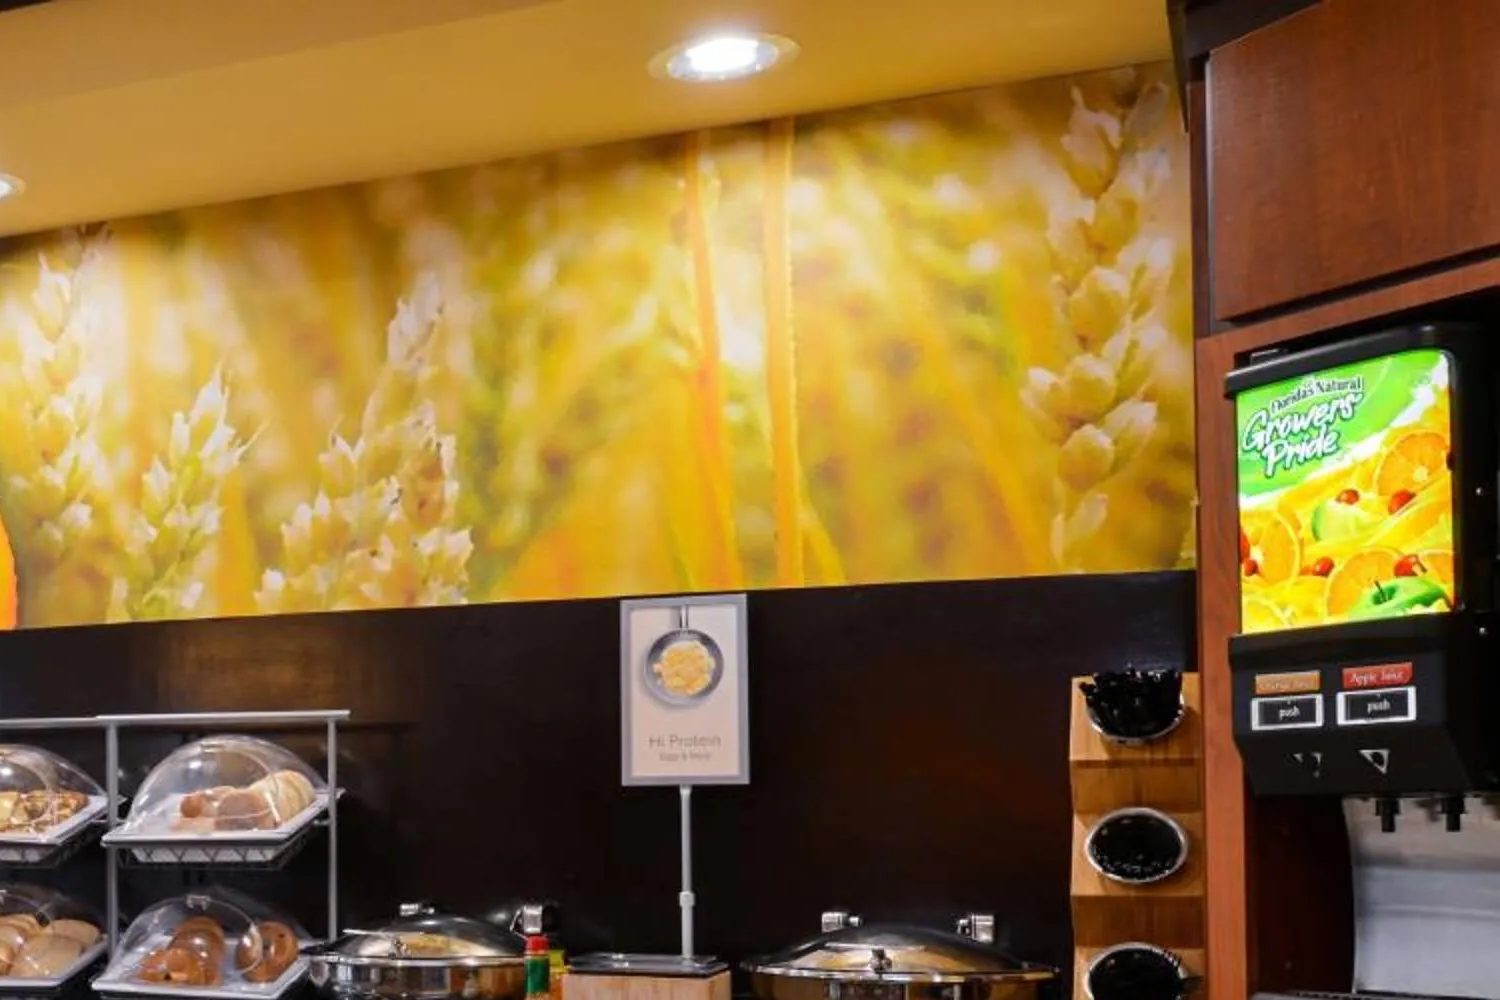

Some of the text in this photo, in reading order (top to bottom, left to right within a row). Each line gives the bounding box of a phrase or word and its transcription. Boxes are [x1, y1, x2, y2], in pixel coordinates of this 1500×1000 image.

[1316, 377, 1363, 393] Natural
[1261, 423, 1341, 478] Pride
[1350, 672, 1377, 686] Apple
[1278, 706, 1300, 720] push
[1367, 698, 1391, 715] push
[669, 733, 722, 748] Protein
